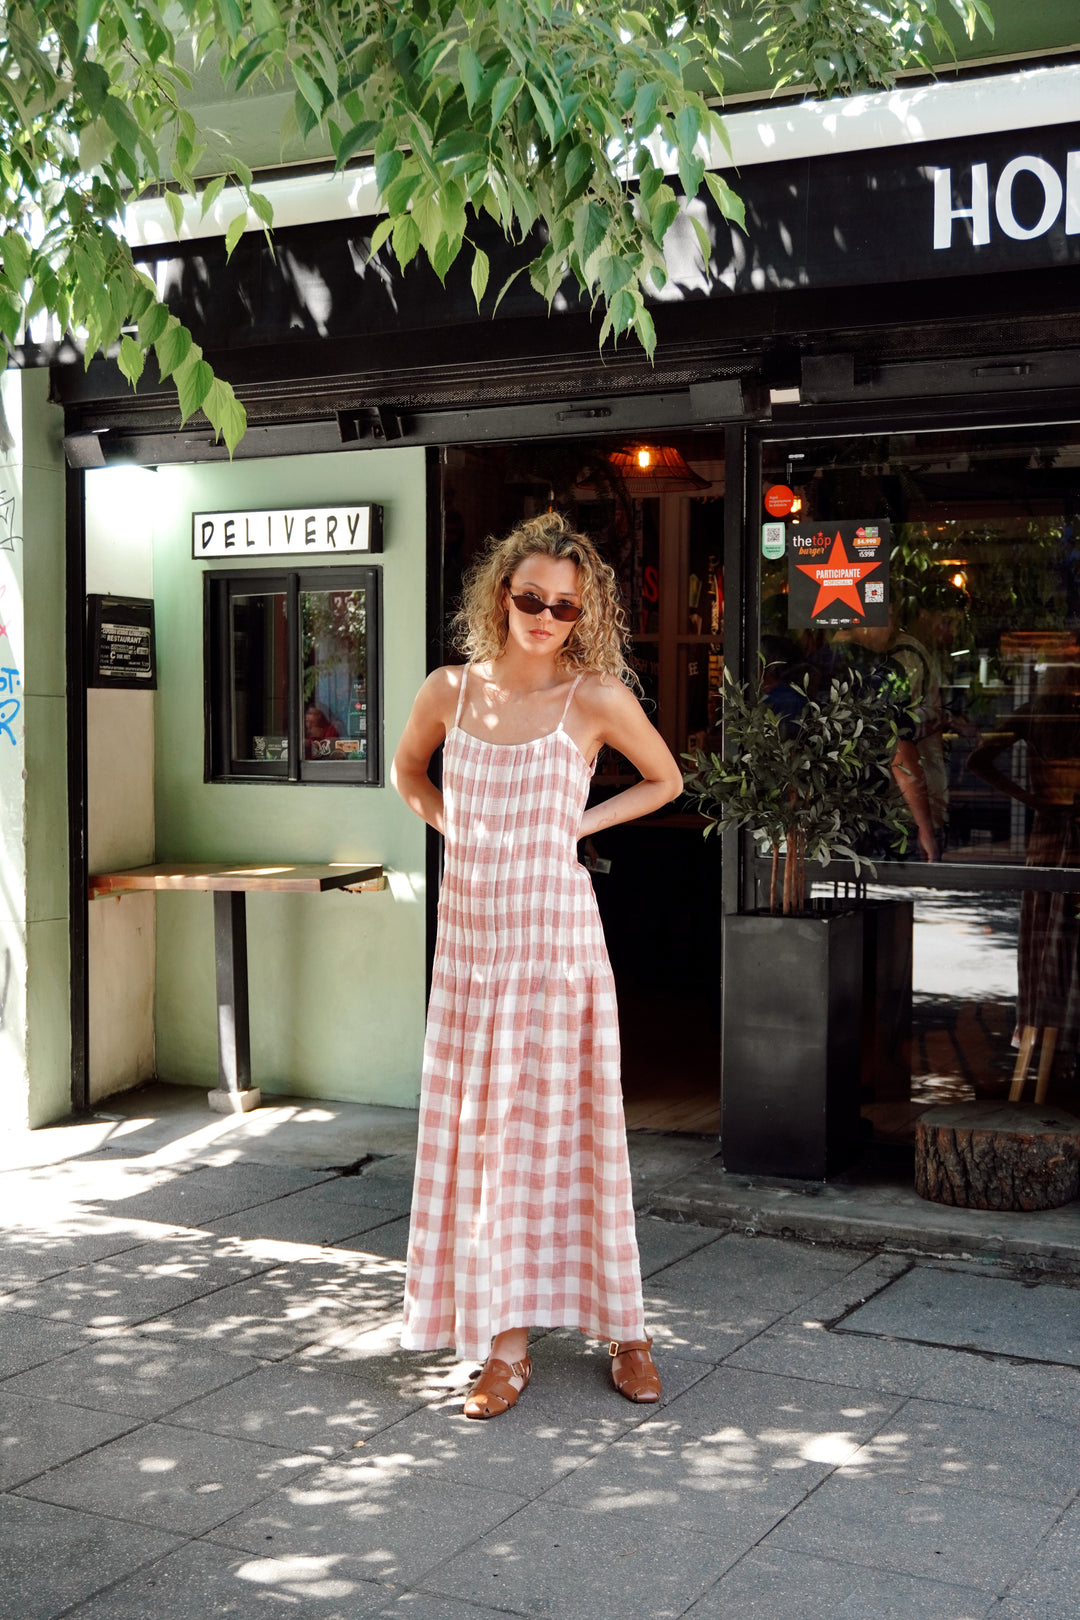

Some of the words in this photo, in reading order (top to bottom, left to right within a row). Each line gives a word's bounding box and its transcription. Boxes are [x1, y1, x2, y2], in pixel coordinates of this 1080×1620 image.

[201, 513, 360, 550] DELIVERY
[799, 546, 824, 557] burger
[816, 568, 861, 579] PARTICIPANTE
[106, 634, 142, 643] RESTAURANT
